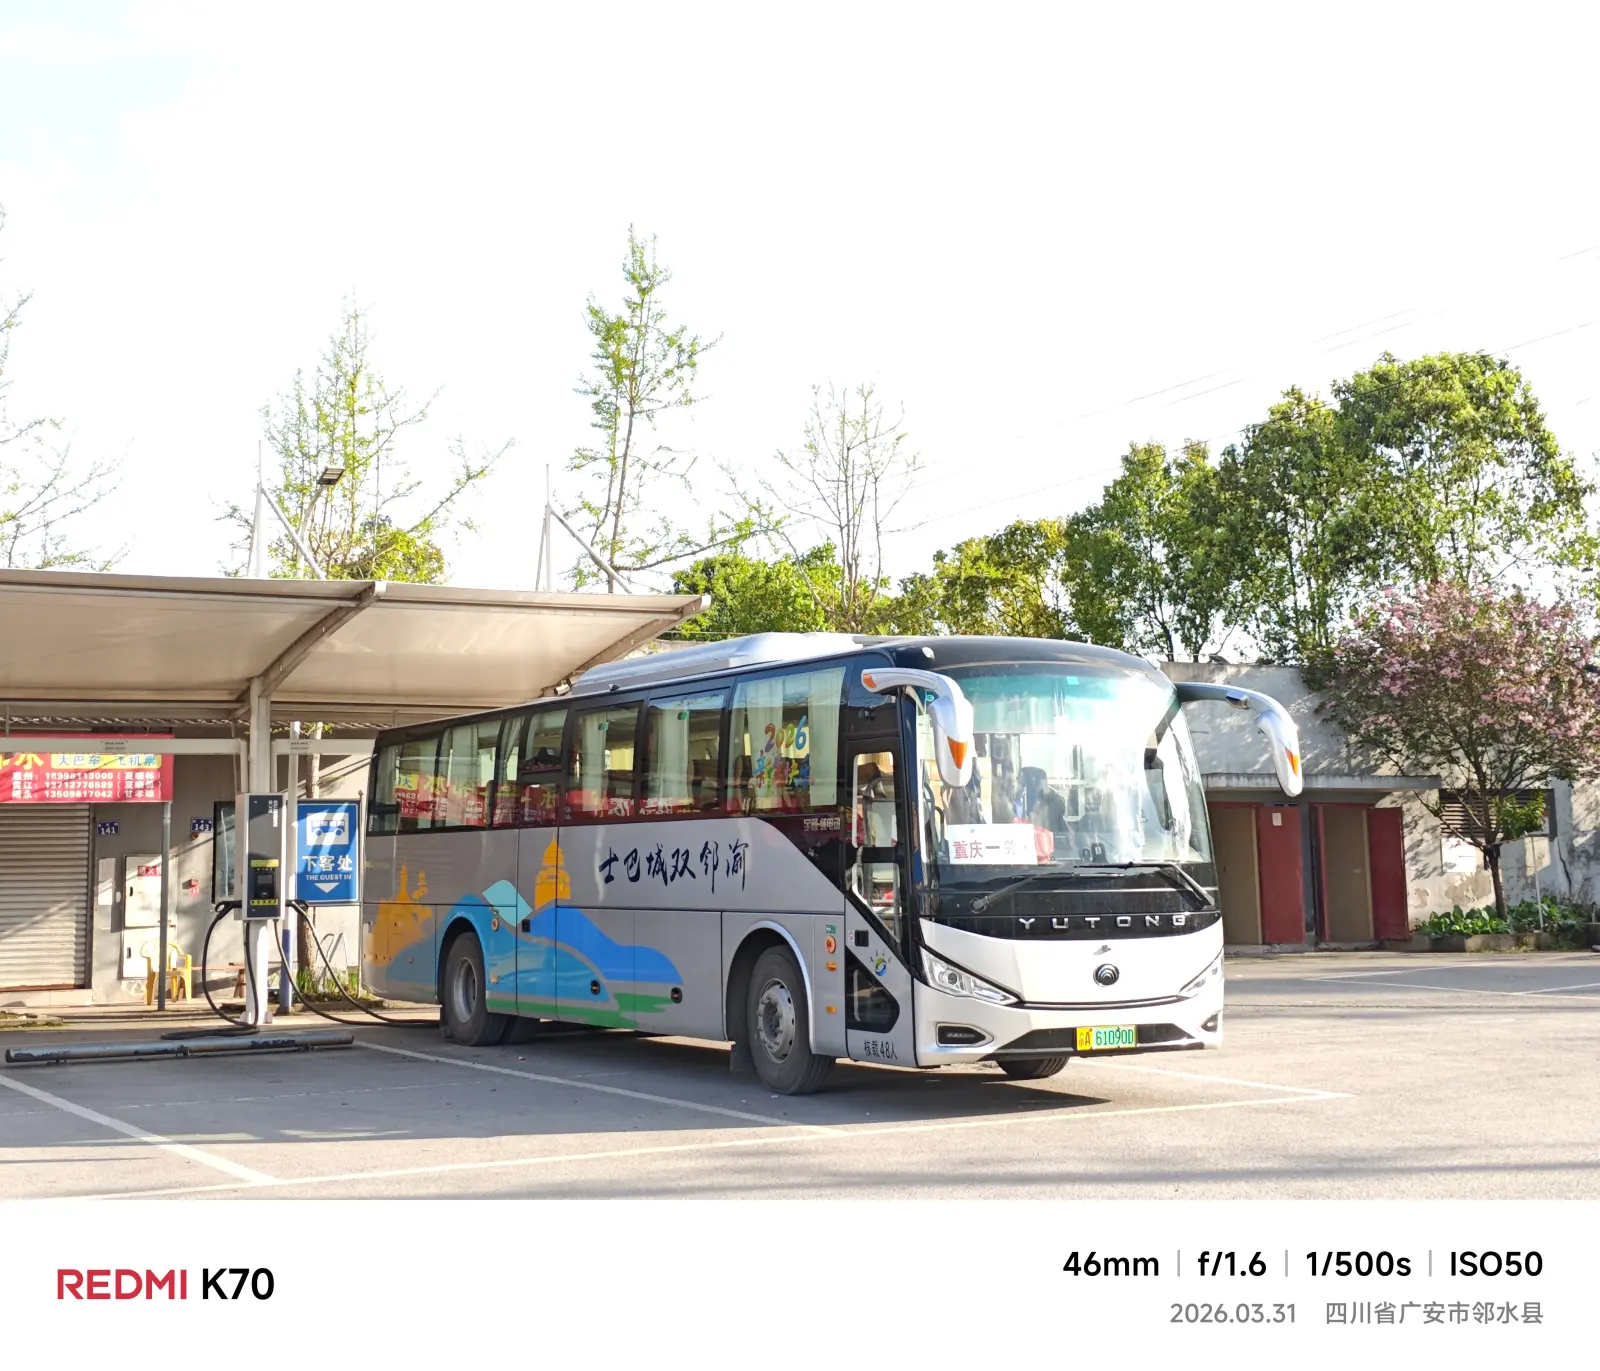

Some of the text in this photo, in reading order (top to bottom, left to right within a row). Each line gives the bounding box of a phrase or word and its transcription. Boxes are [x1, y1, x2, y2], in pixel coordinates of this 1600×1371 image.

[765, 715, 807, 752] 2026
[101, 826, 116, 835] 141
[194, 823, 209, 832] 143
[302, 854, 353, 872] 下客处
[1019, 915, 1186, 929] YUTONG
[864, 1040, 898, 1060] 核载48人
